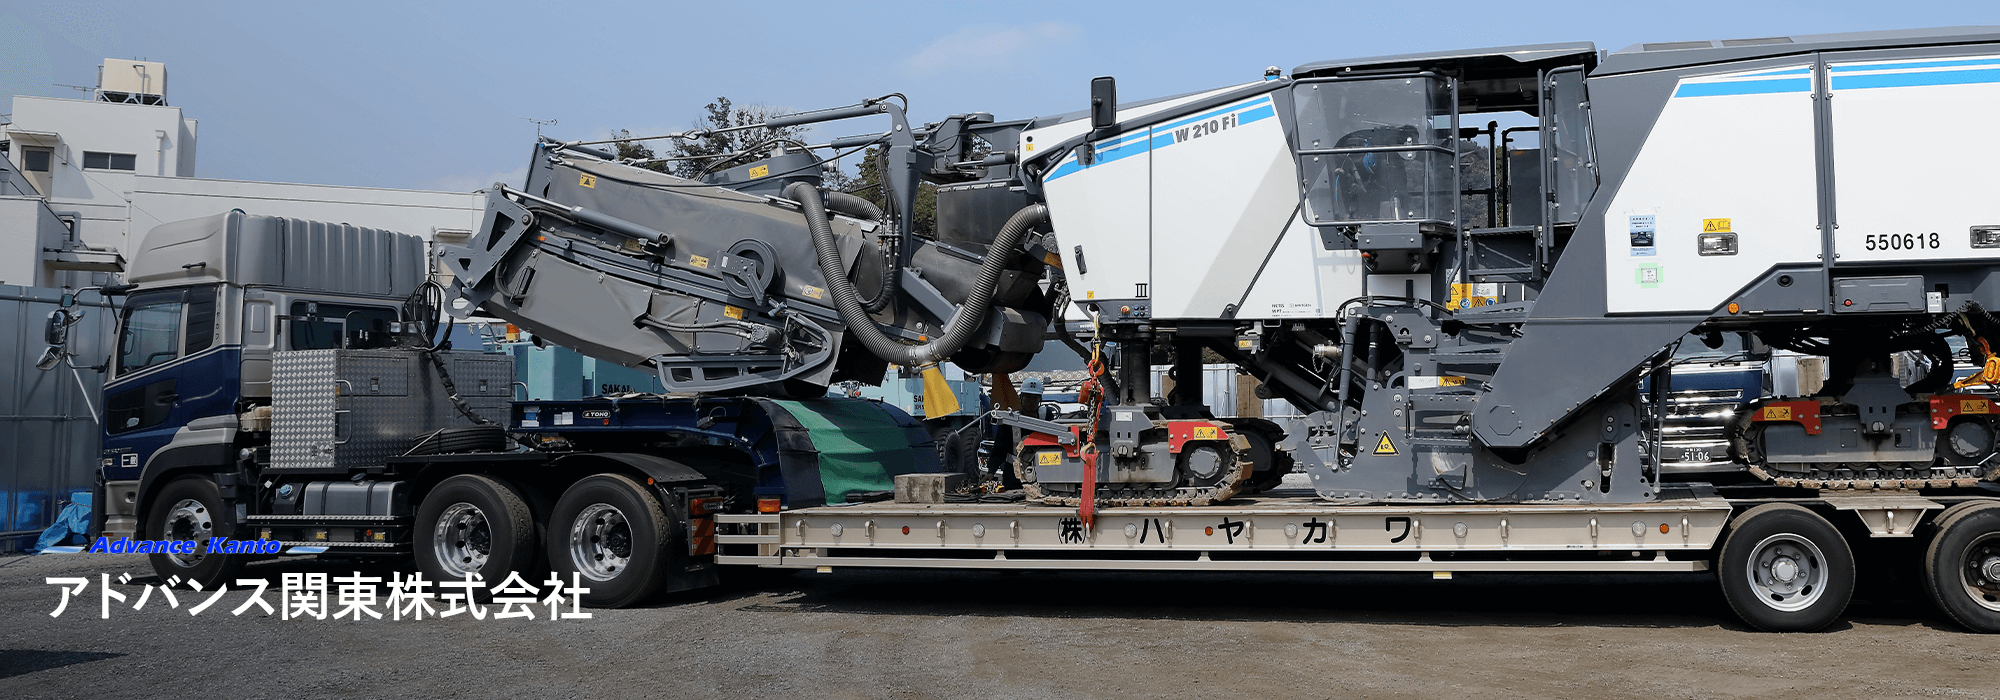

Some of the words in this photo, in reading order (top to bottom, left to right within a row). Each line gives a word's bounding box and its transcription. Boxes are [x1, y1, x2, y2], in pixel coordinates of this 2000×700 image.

[1175, 127, 1190, 143] W
[1193, 119, 1219, 139] 210
[1222, 113, 1236, 131] Fi
[1865, 232, 1940, 251] 550618
